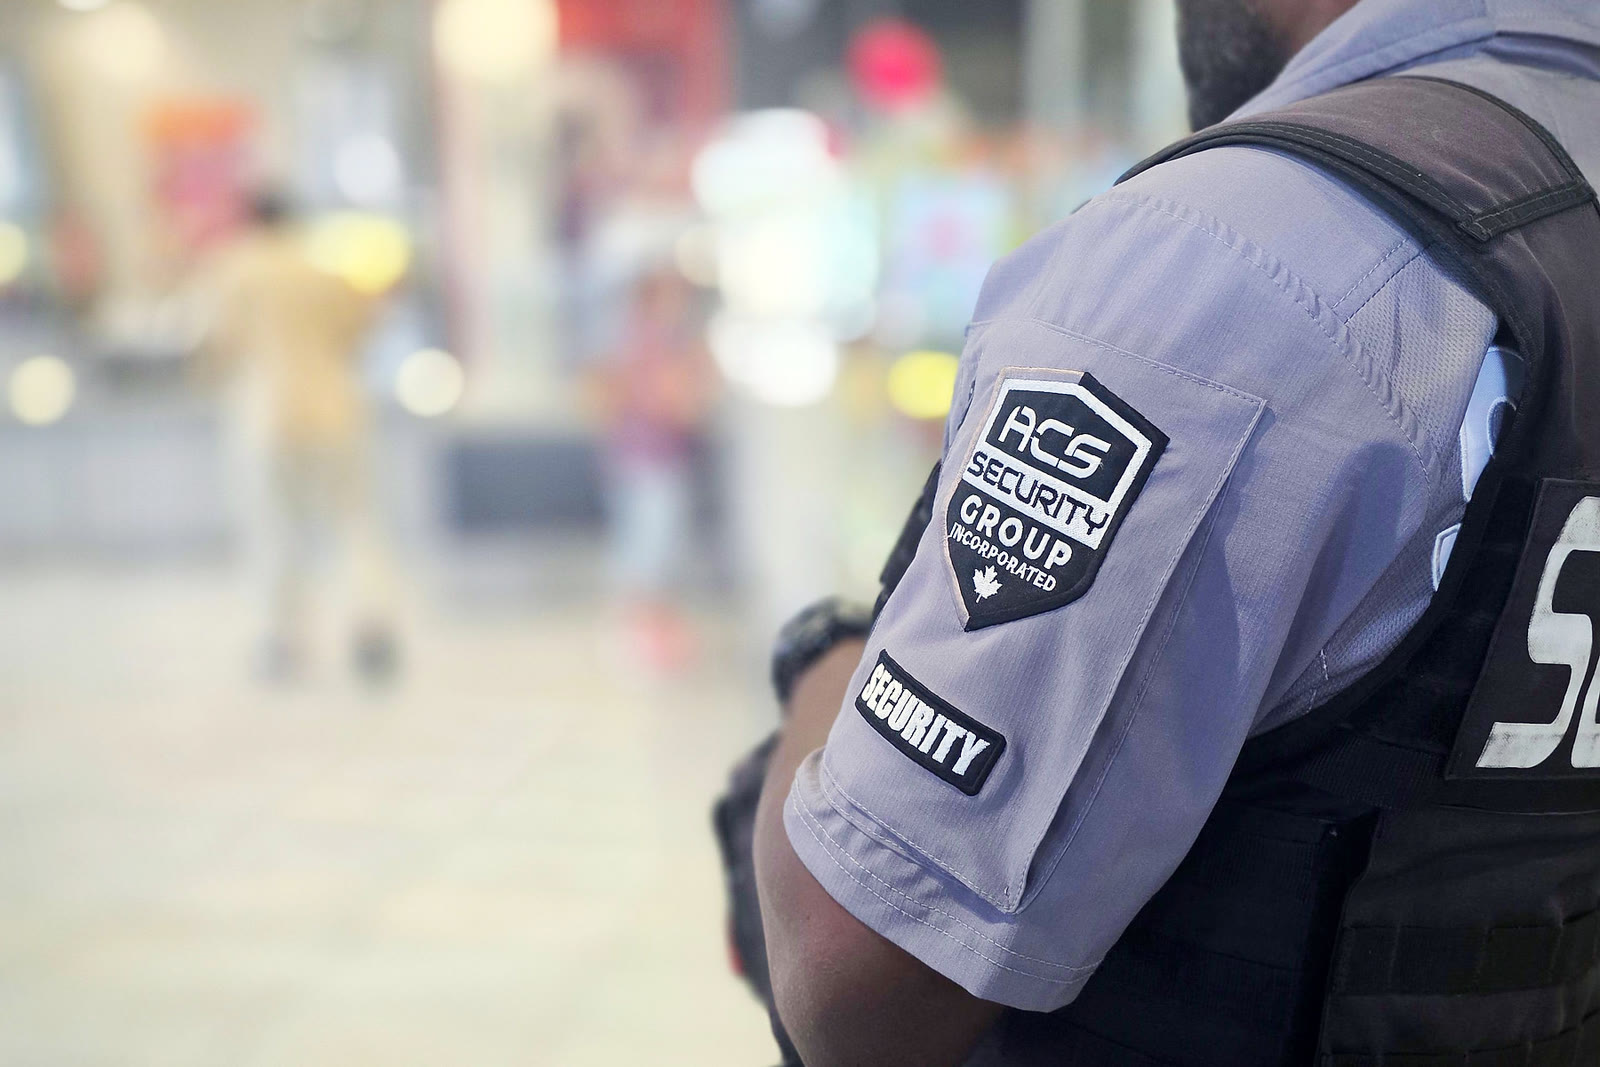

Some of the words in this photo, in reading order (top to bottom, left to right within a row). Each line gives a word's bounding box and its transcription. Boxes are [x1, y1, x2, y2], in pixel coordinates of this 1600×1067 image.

[998, 405, 1112, 479] ACS
[960, 494, 1073, 570] GROUP
[967, 451, 1110, 535] SECURITY
[950, 521, 1057, 592] INCORPORATED
[1475, 496, 1600, 769] S
[861, 662, 991, 776] SECURITY
